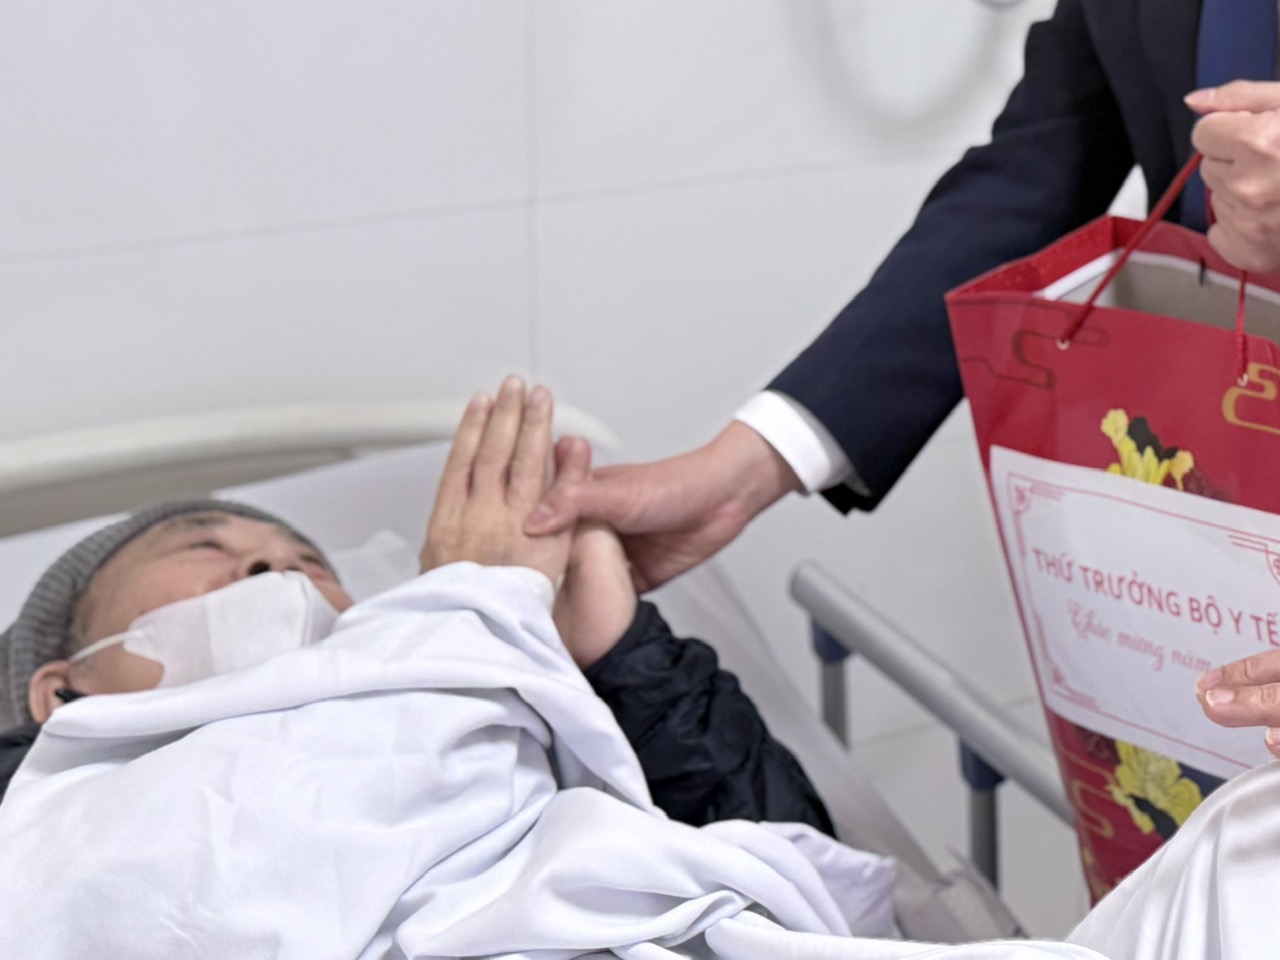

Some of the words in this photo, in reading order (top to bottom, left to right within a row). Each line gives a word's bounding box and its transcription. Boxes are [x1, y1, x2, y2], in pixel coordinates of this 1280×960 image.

[1032, 546, 1074, 583] THỨ
[1078, 565, 1182, 618] TRƯỞNG
[1187, 593, 1222, 635] BỘ
[1228, 606, 1243, 636] Y
[1249, 610, 1280, 648] TẾ
